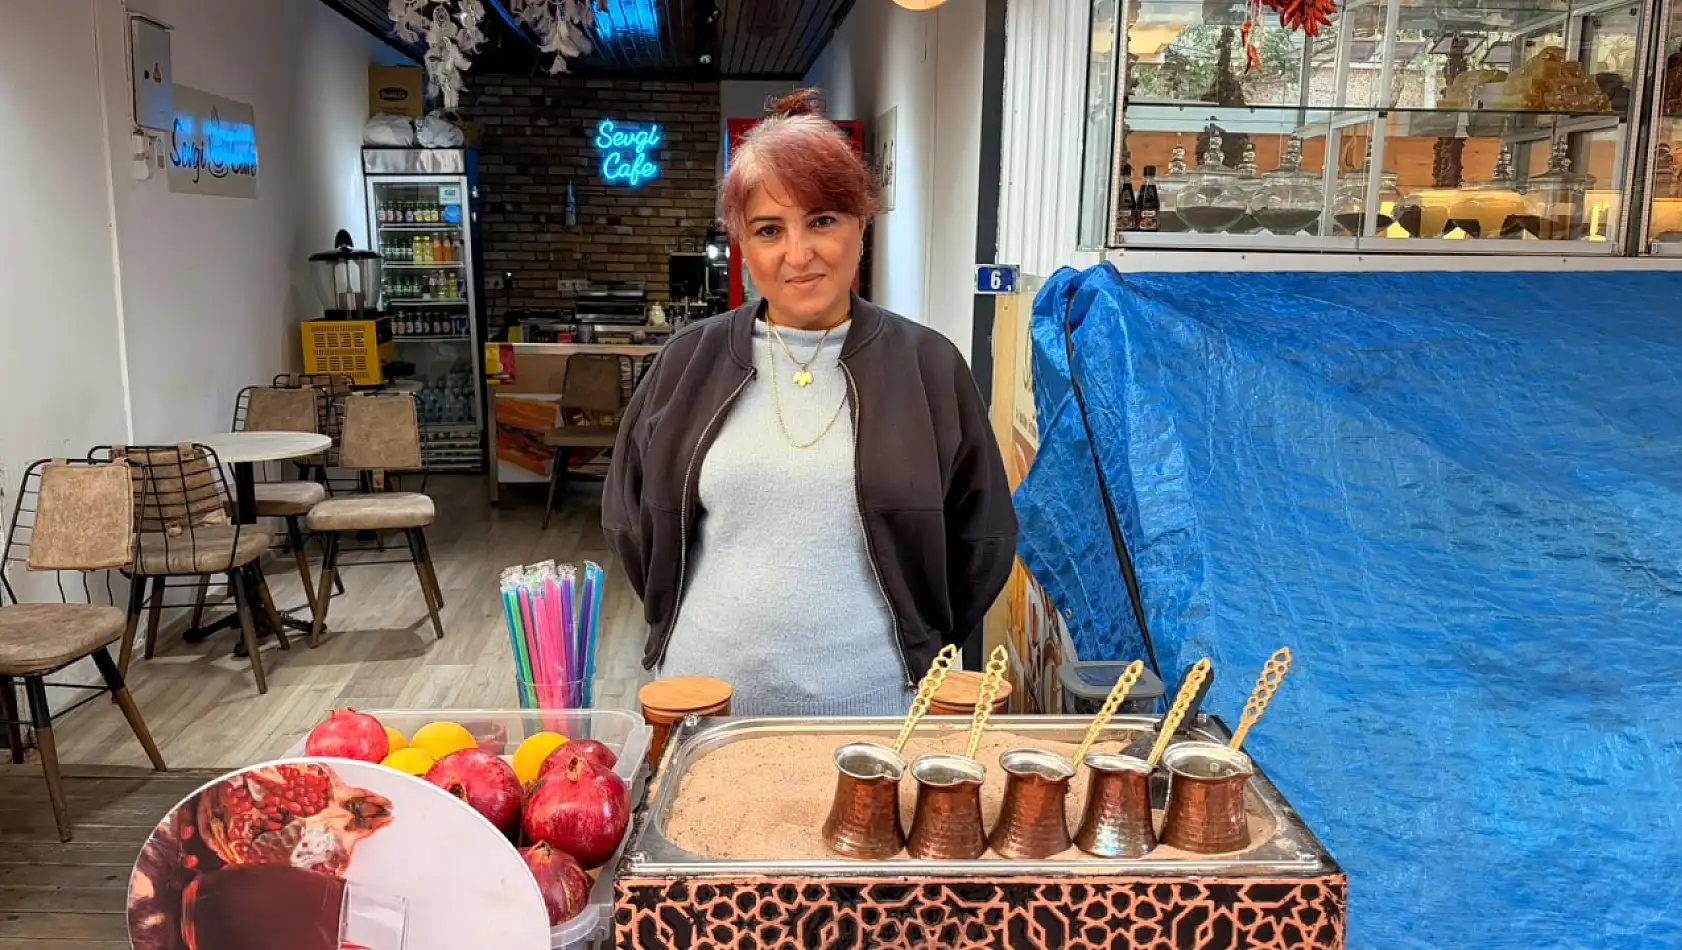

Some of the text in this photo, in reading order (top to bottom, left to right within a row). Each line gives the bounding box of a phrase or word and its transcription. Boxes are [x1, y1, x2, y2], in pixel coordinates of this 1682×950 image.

[169, 117, 206, 184] Sevgi
[596, 120, 660, 153] Sevgi
[602, 152, 657, 186] Cafe
[990, 270, 1001, 290] 6
